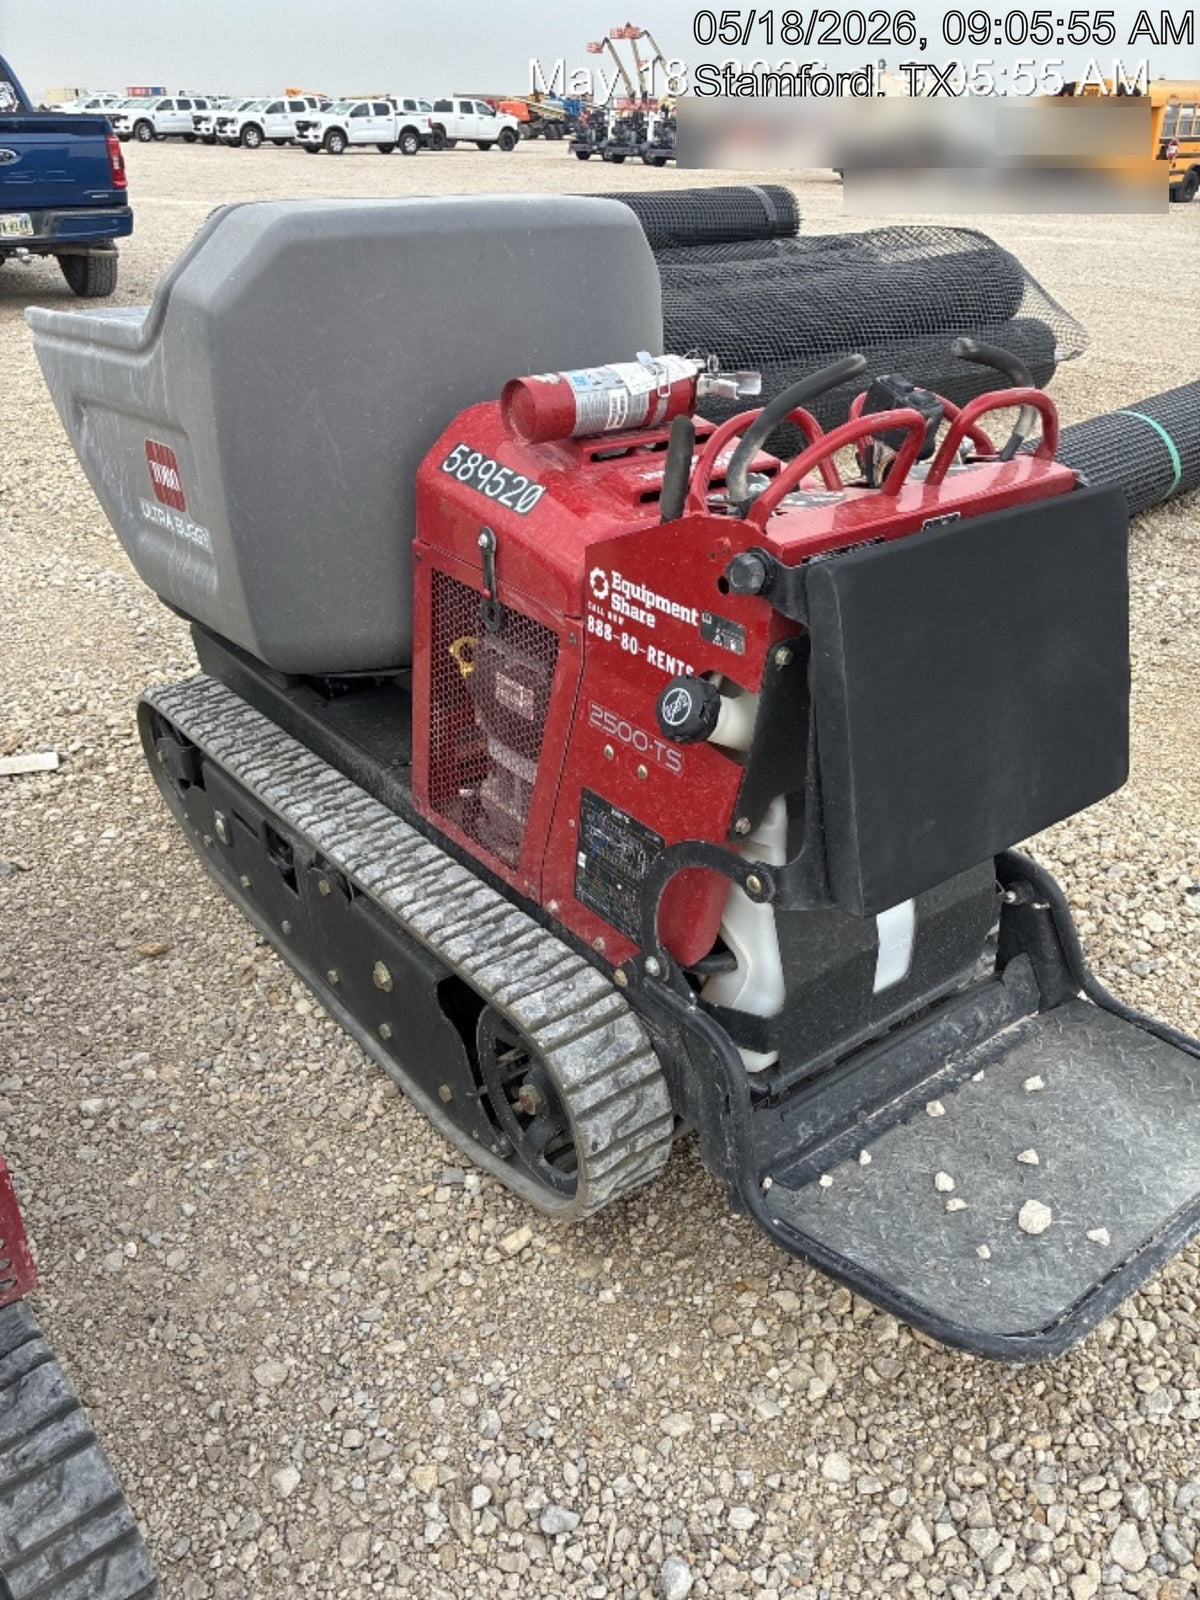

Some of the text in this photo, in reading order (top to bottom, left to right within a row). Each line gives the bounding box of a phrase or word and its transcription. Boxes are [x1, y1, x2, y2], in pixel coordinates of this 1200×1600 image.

[442, 444, 547, 513] 589520
[611, 570, 699, 626] Equipment
[611, 593, 656, 629] Share
[587, 615, 695, 677] 888-80-RENTS
